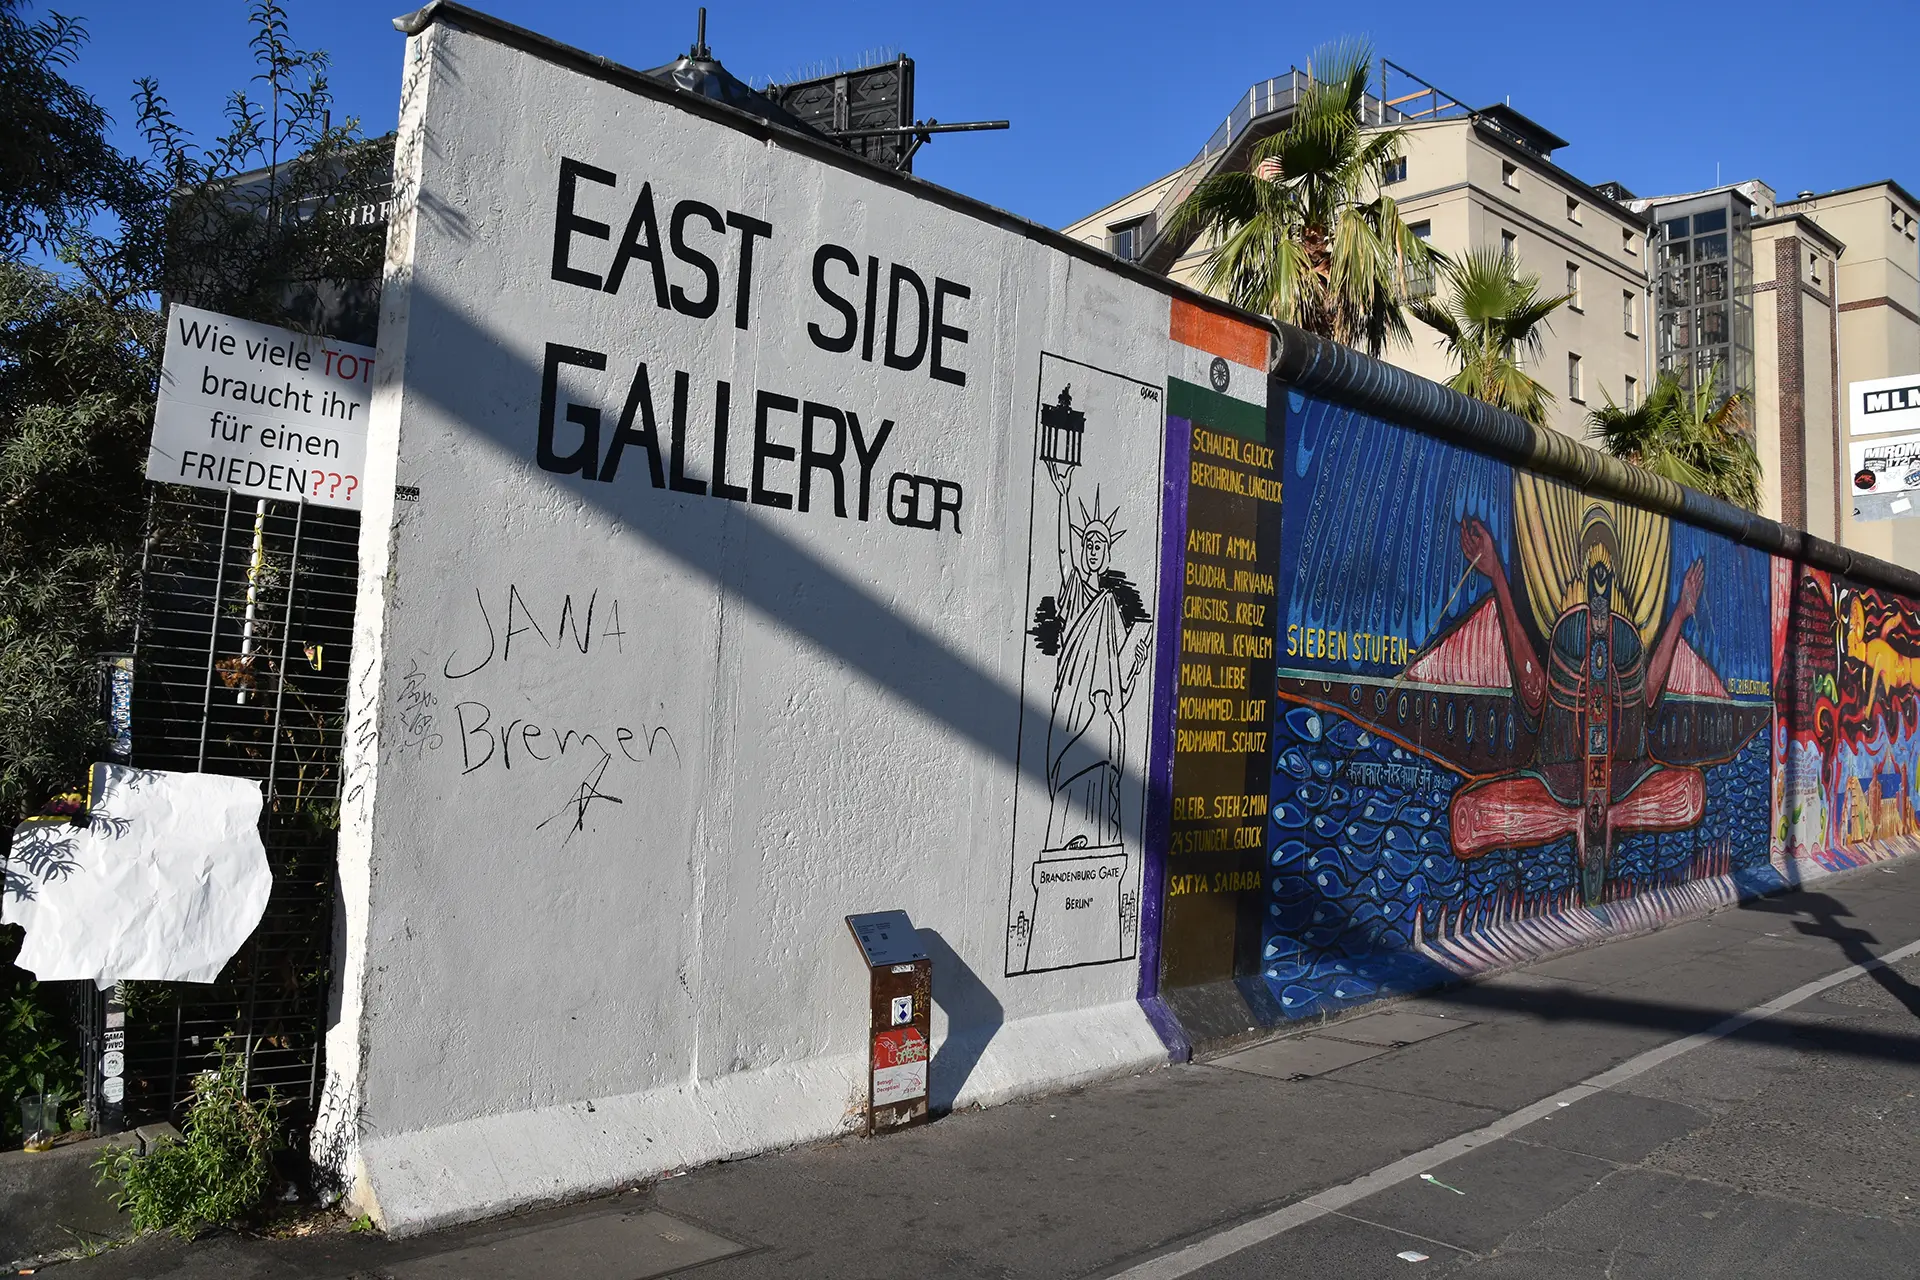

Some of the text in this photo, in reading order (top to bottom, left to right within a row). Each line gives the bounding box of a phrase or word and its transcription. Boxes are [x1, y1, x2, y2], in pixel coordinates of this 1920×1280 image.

[551, 156, 971, 388] EAST SIDE
[179, 318, 236, 355] Wie
[246, 337, 311, 371] viele
[201, 365, 361, 421] braucht ihr
[210, 411, 340, 459] für einen
[536, 342, 963, 535] GALLERY GDR
[180, 450, 359, 501] FRIEDEN???
[1187, 529, 1257, 561] AMRIT AMMA
[444, 583, 626, 679] JANA
[1235, 602, 1265, 627] KREUZ
[1286, 624, 1348, 661] SIEBEN
[1220, 666, 1246, 690] LIEBE
[1240, 700, 1266, 722] LICHT
[454, 702, 681, 775] Bremen
[1232, 732, 1267, 753] SCHUTZ
[1214, 795, 1240, 818] STEH
[1040, 866, 1119, 884] BRANDENBURG GATE
[1170, 871, 1261, 896] SATYA SAIBABA
